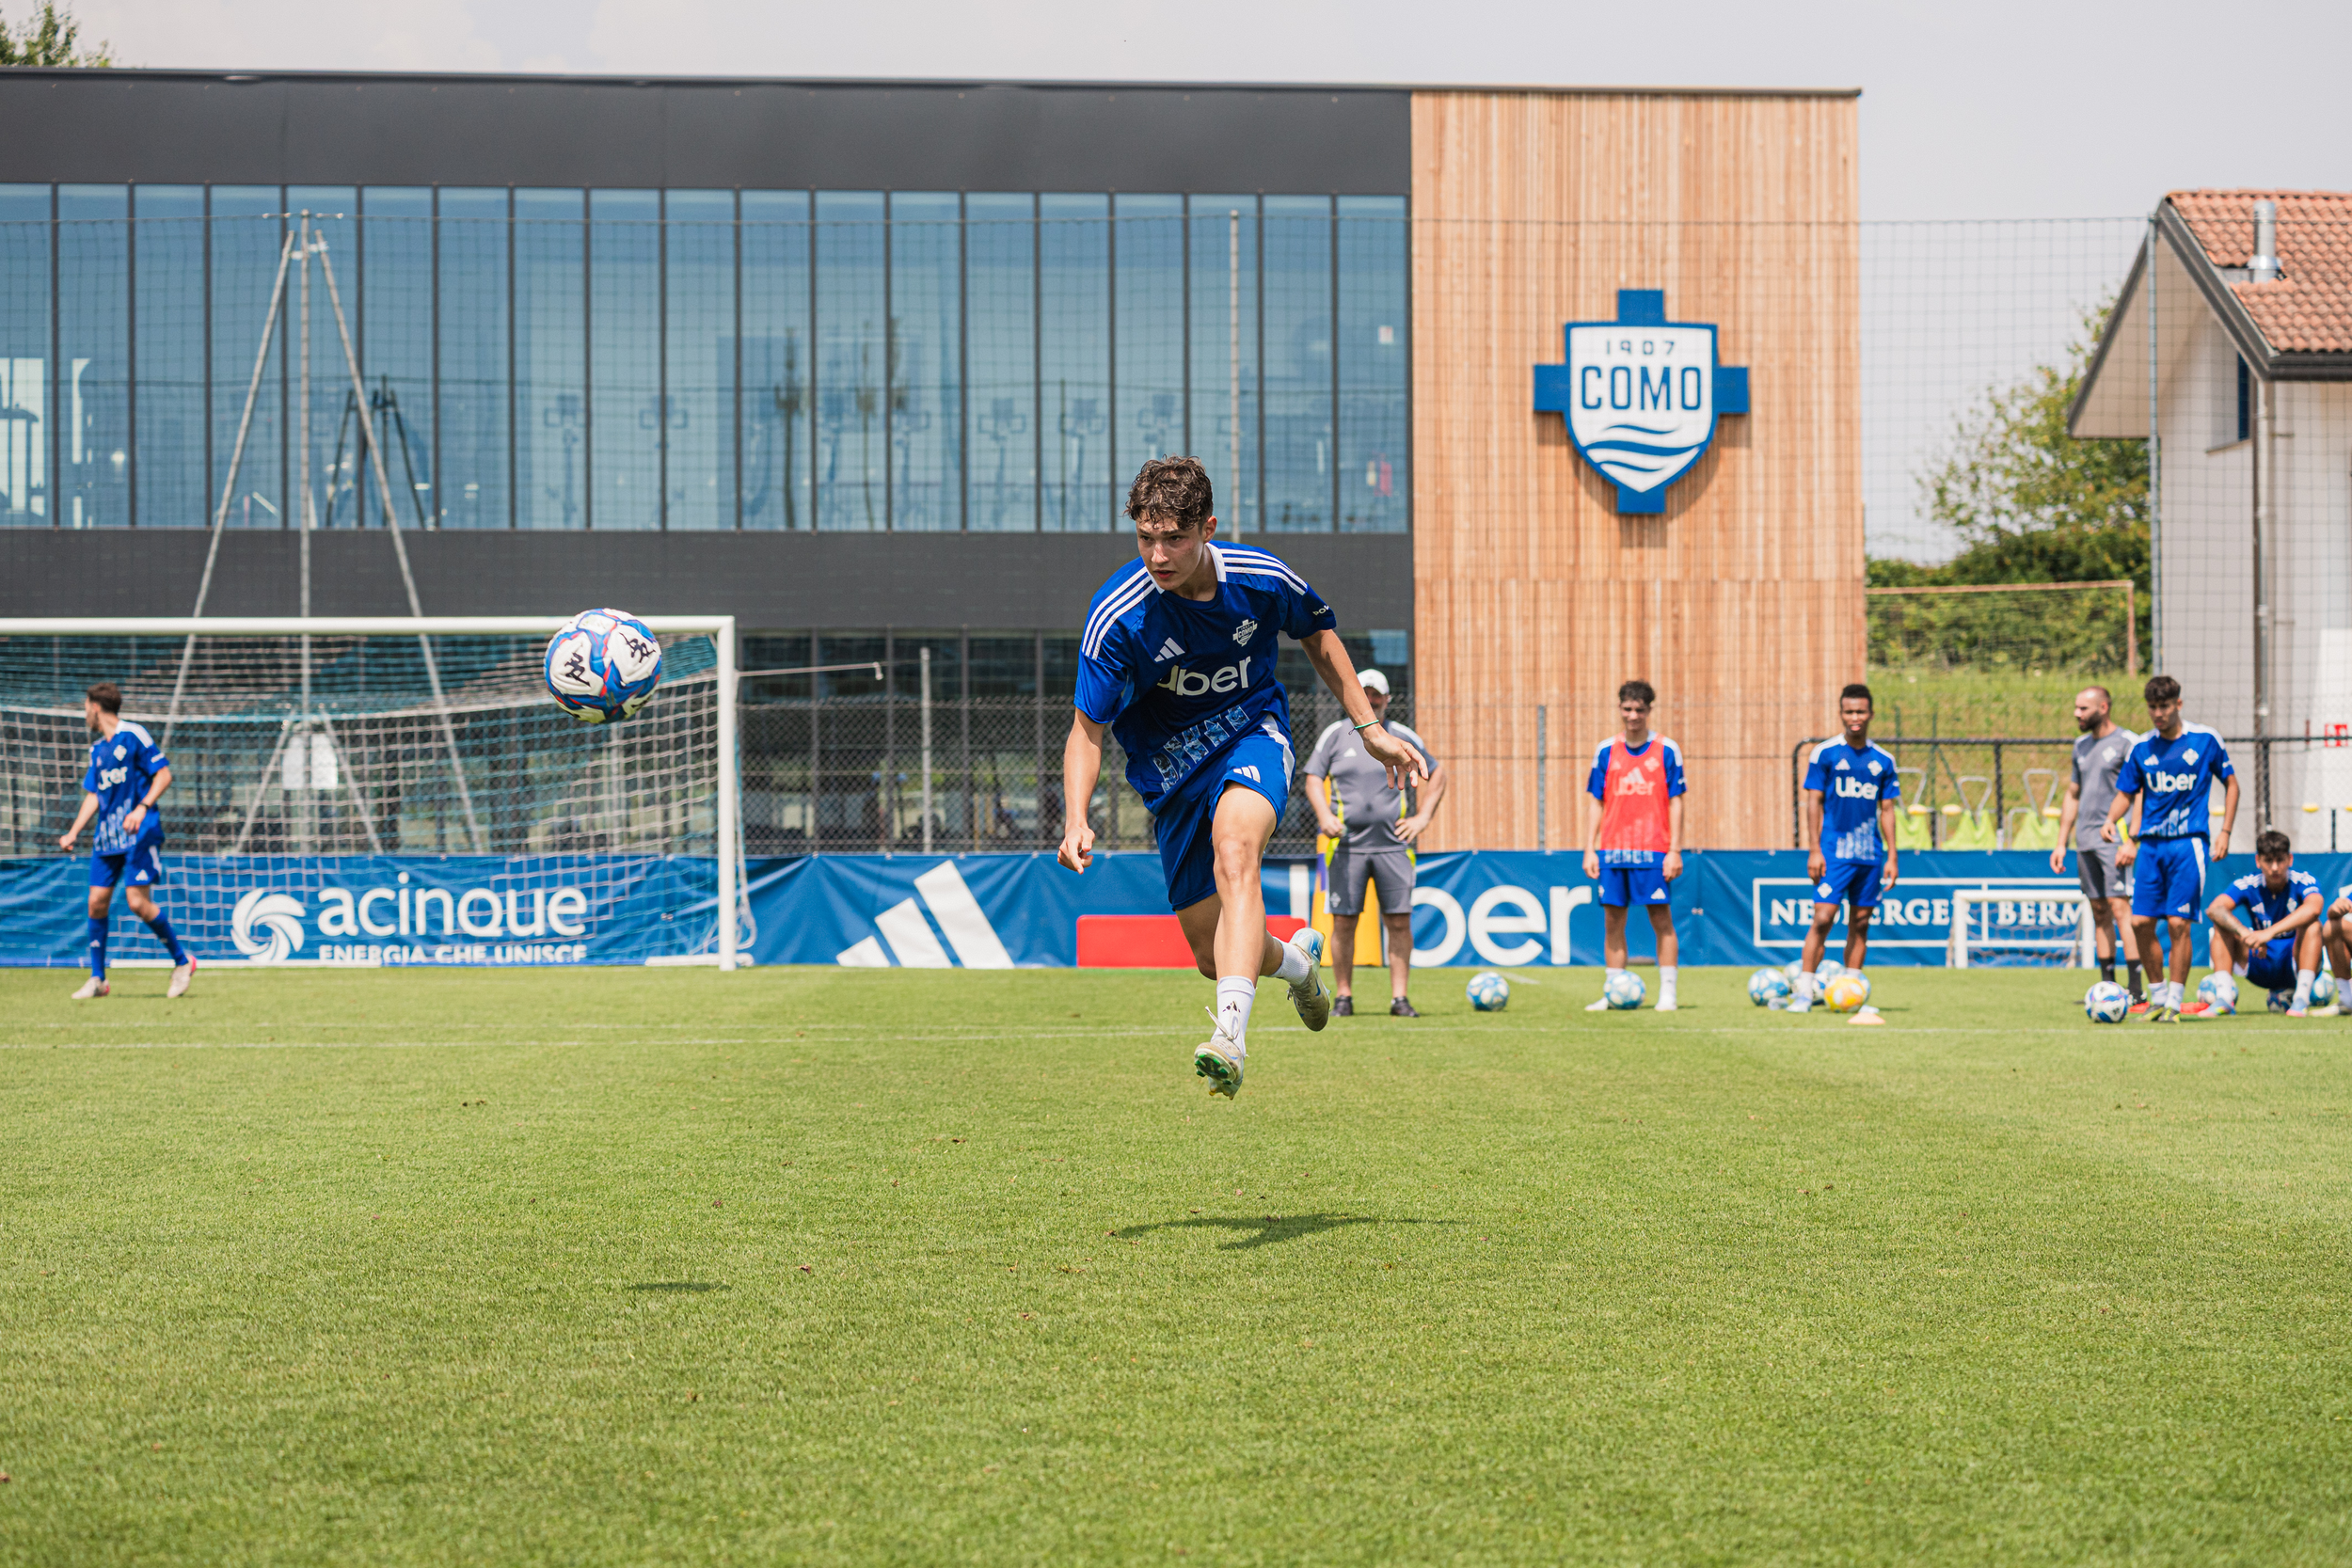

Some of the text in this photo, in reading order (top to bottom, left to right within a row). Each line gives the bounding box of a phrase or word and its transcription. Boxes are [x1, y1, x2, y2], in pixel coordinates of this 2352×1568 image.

[1606, 341, 1675, 355] 1907
[1581, 366, 1701, 410] COMO
[1836, 776, 1879, 800] Uber
[2146, 770, 2198, 793] Uber
[318, 871, 587, 937] acinque
[319, 944, 427, 962] ENERGIA
